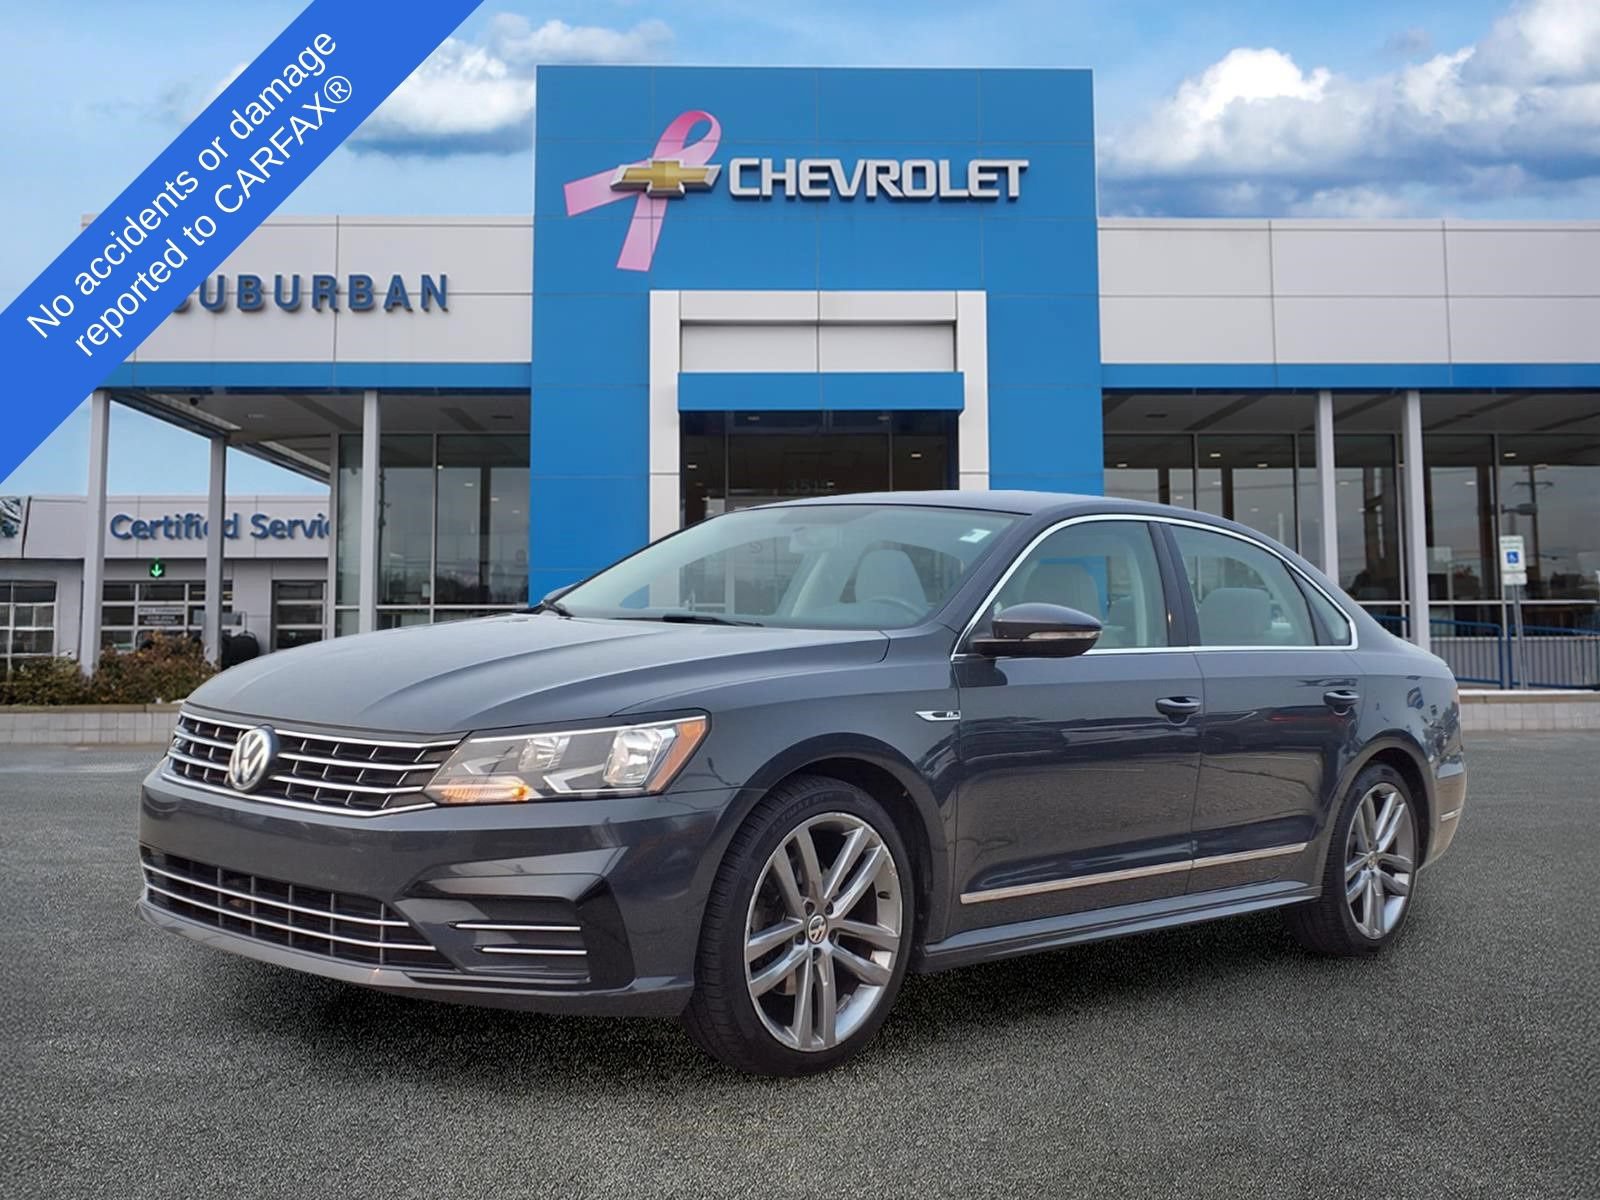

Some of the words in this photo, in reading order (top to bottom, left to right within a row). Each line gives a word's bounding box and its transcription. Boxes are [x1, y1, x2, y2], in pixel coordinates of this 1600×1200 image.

[729, 158, 1029, 199] CHEVROLET
[174, 274, 449, 312] UBURBAN
[110, 513, 239, 540] Certifid
